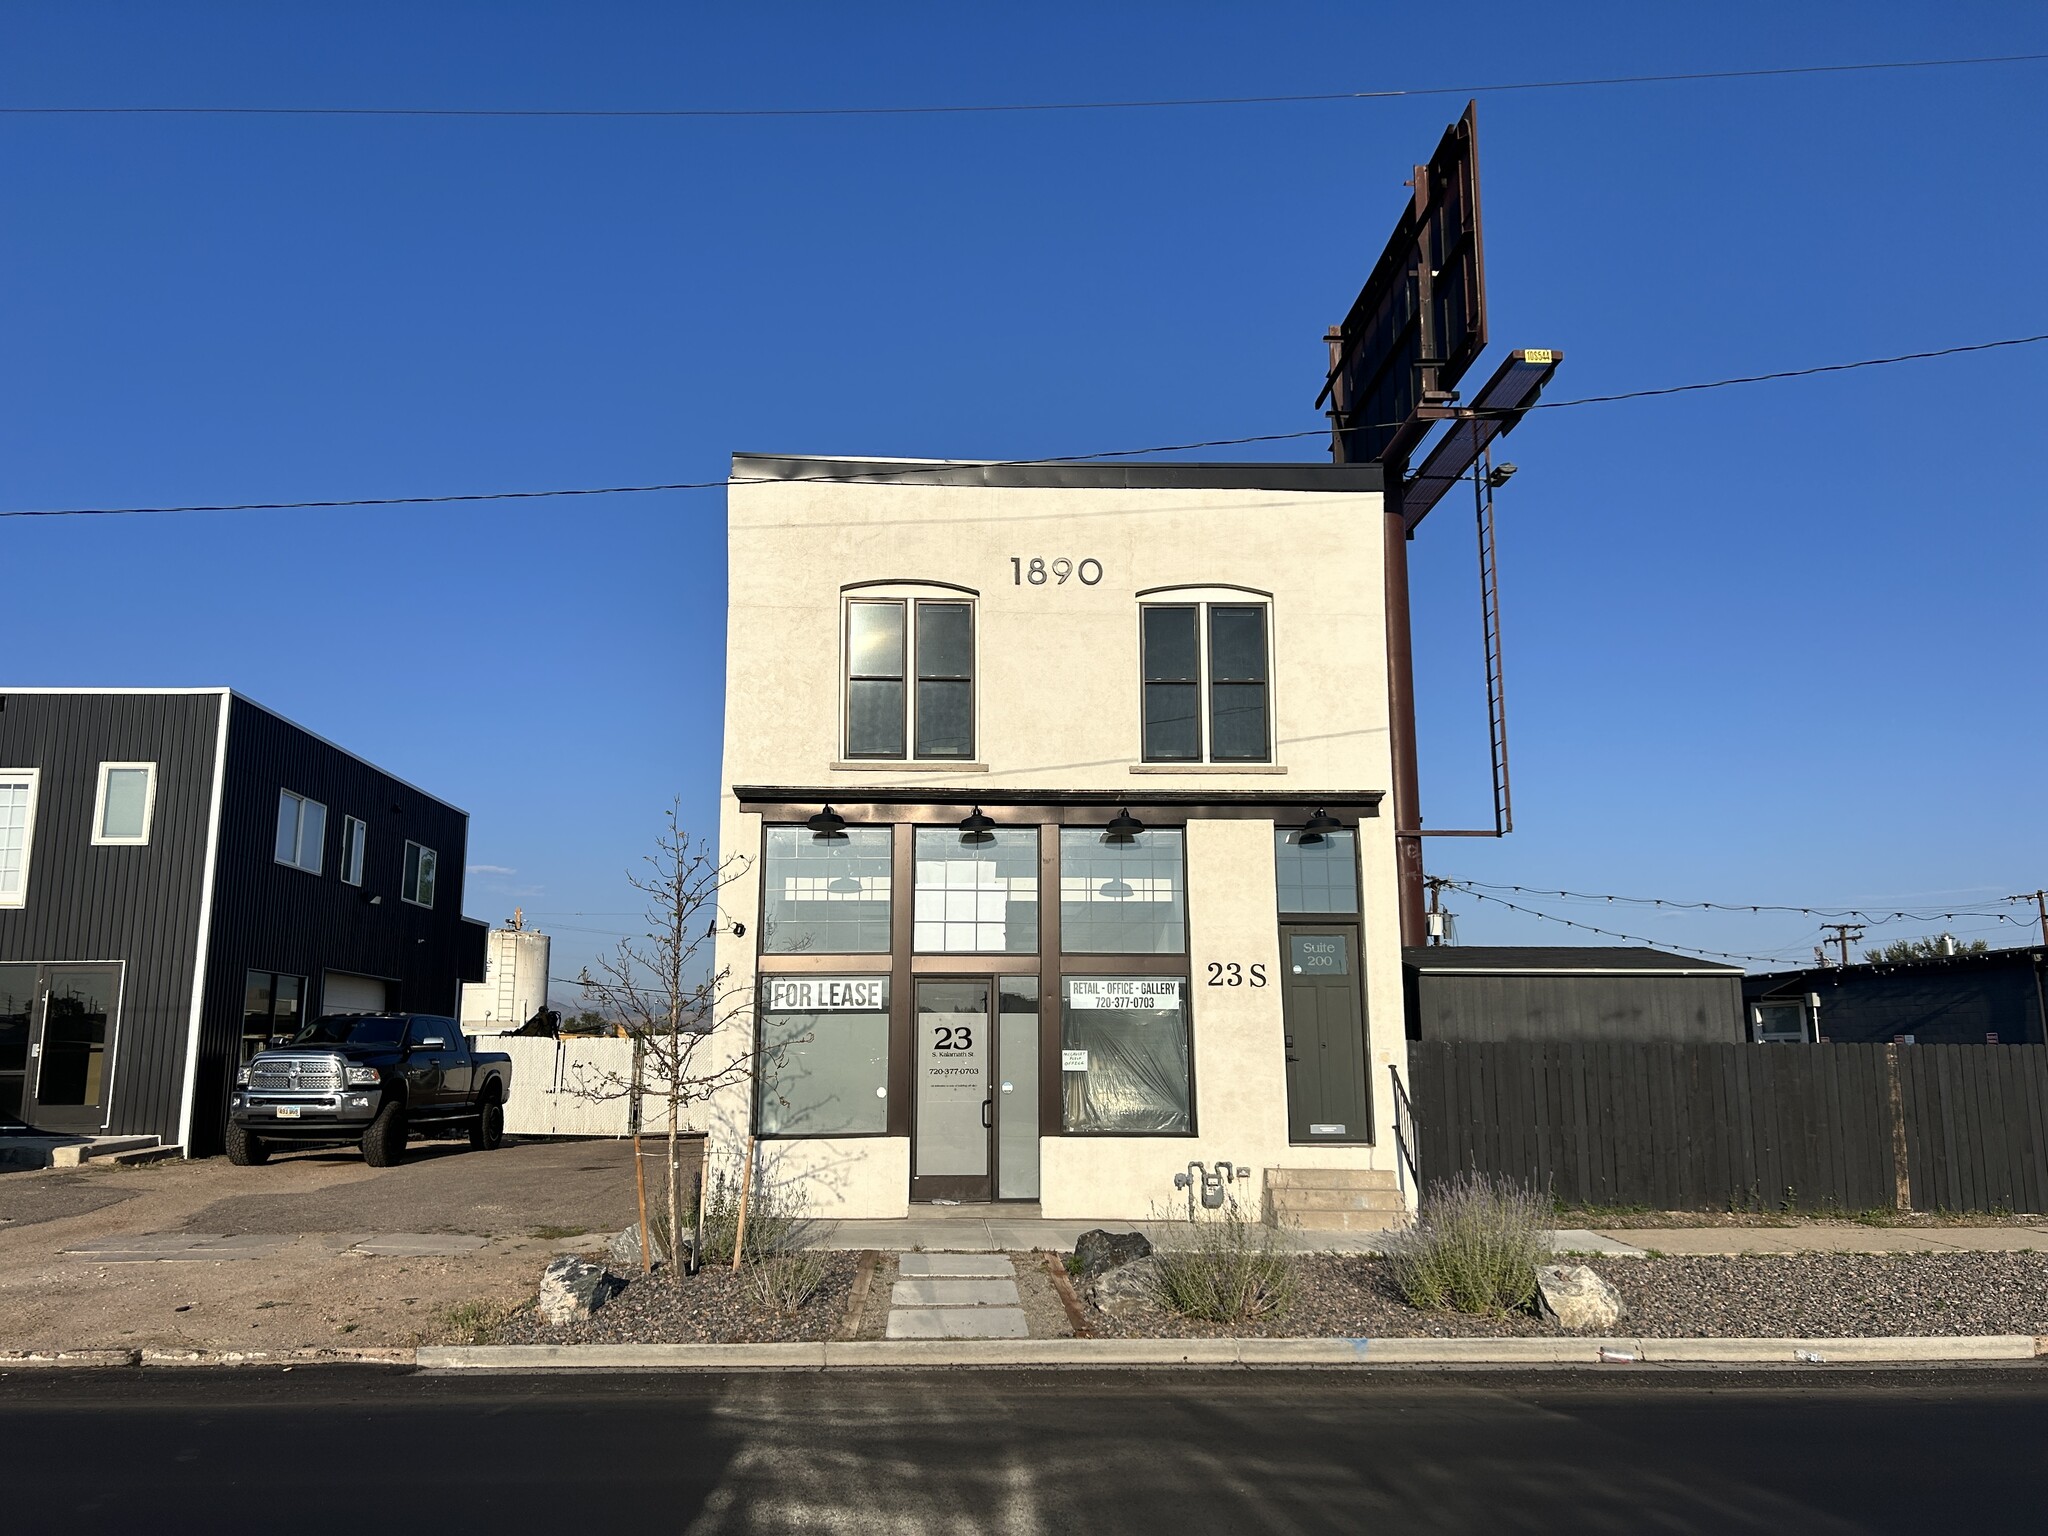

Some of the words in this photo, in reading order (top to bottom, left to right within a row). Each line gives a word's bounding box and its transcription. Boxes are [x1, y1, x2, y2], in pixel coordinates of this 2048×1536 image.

[1010, 557, 1103, 586] 1890
[1303, 942, 1336, 954] Suite
[1307, 955, 1333, 967] 200
[1207, 962, 1243, 987] 23
[1249, 963, 1267, 988] S
[774, 983, 812, 1007] FOR
[818, 983, 879, 1007] LEASE
[1073, 982, 1100, 995] RETAIL
[1107, 982, 1134, 995] OFFICE
[1141, 982, 1176, 995] GALLERY
[1095, 997, 1155, 1009] 720-377-0703
[934, 1027, 973, 1050] 23
